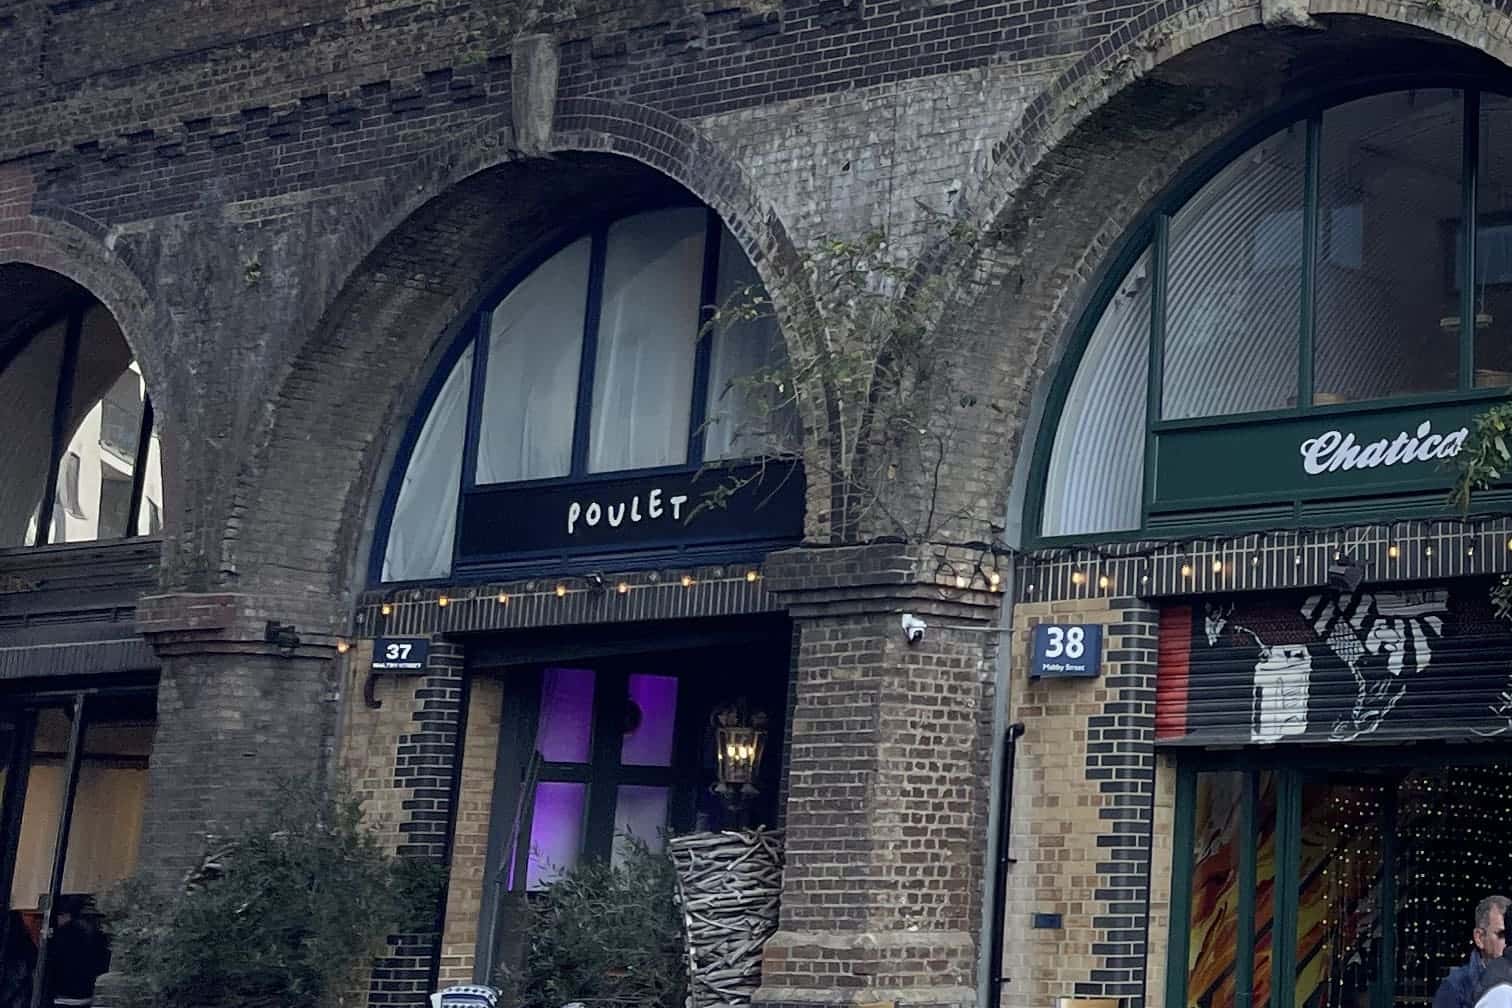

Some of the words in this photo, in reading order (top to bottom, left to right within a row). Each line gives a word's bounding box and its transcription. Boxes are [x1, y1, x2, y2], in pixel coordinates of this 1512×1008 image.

[1300, 420, 1469, 475] Chatica
[567, 488, 688, 534] POULET
[386, 643, 412, 660] 37
[1045, 626, 1085, 659] 38
